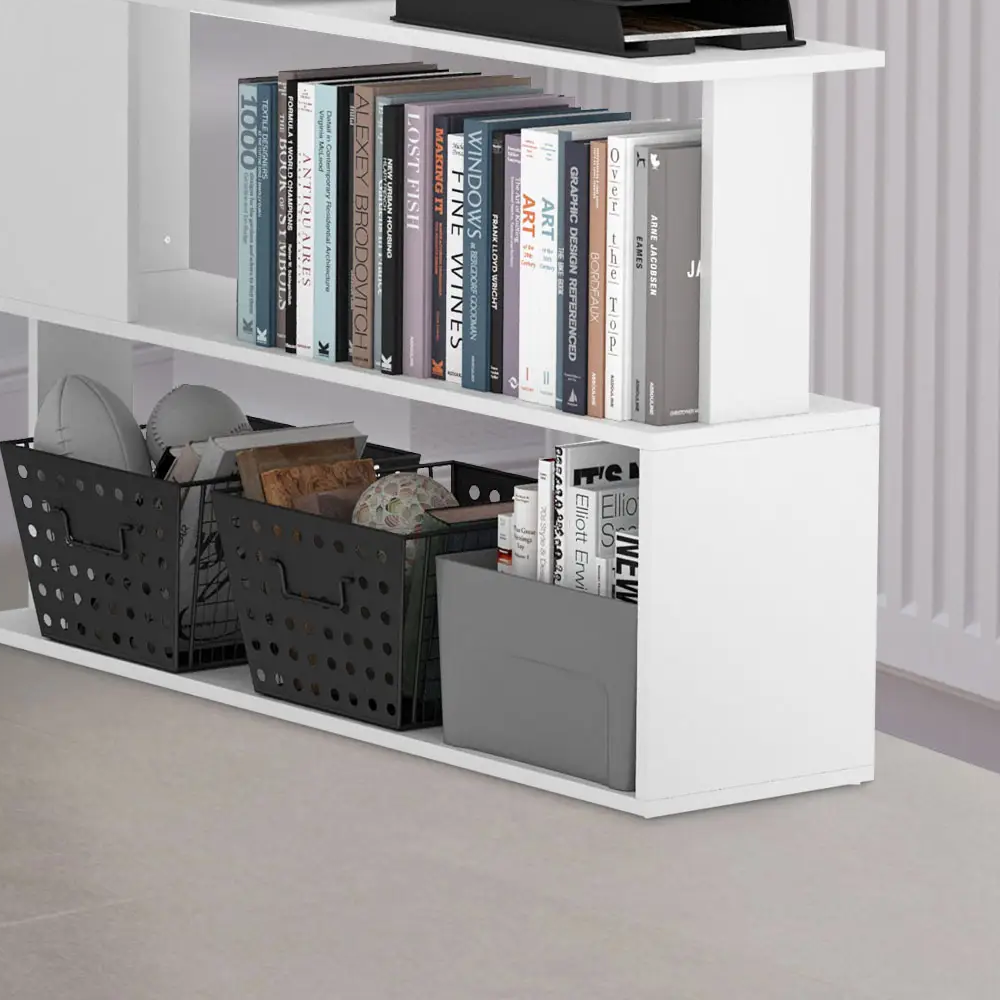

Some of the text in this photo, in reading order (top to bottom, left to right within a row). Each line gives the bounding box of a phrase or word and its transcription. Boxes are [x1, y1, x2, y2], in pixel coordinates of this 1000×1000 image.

[240, 95, 257, 169] 1000
[279, 137, 287, 192] BOOK
[355, 93, 370, 188] ALEXEY
[435, 127, 444, 193] MAKING
[406, 112, 421, 230] LOST FISH
[451, 170, 464, 236] FINE
[466, 130, 482, 240] WINDOWS
[569, 166, 579, 223] GRAPHIC
[301, 152, 312, 288] ANTIQUAIRES
[435, 197, 444, 216] IT
[522, 193, 536, 239] ART
[541, 197, 556, 242] ART
[278, 214, 287, 311] SYMBOLS
[354, 194, 369, 350] BRODOVITCH
[470, 250, 478, 295] BERGDORF
[491, 213, 499, 311] FRANK LLOYD WRIGHT
[569, 227, 578, 274] DESIGN
[635, 235, 643, 270] EAMES
[650, 214, 658, 297] ARNE JACOBSEN
[450, 253, 463, 349] WINES
[469, 296, 478, 341] GOODMAN
[568, 278, 578, 362] REFERENCED
[590, 252, 600, 323] BORDEAUX
[575, 493, 590, 543] Elliott
